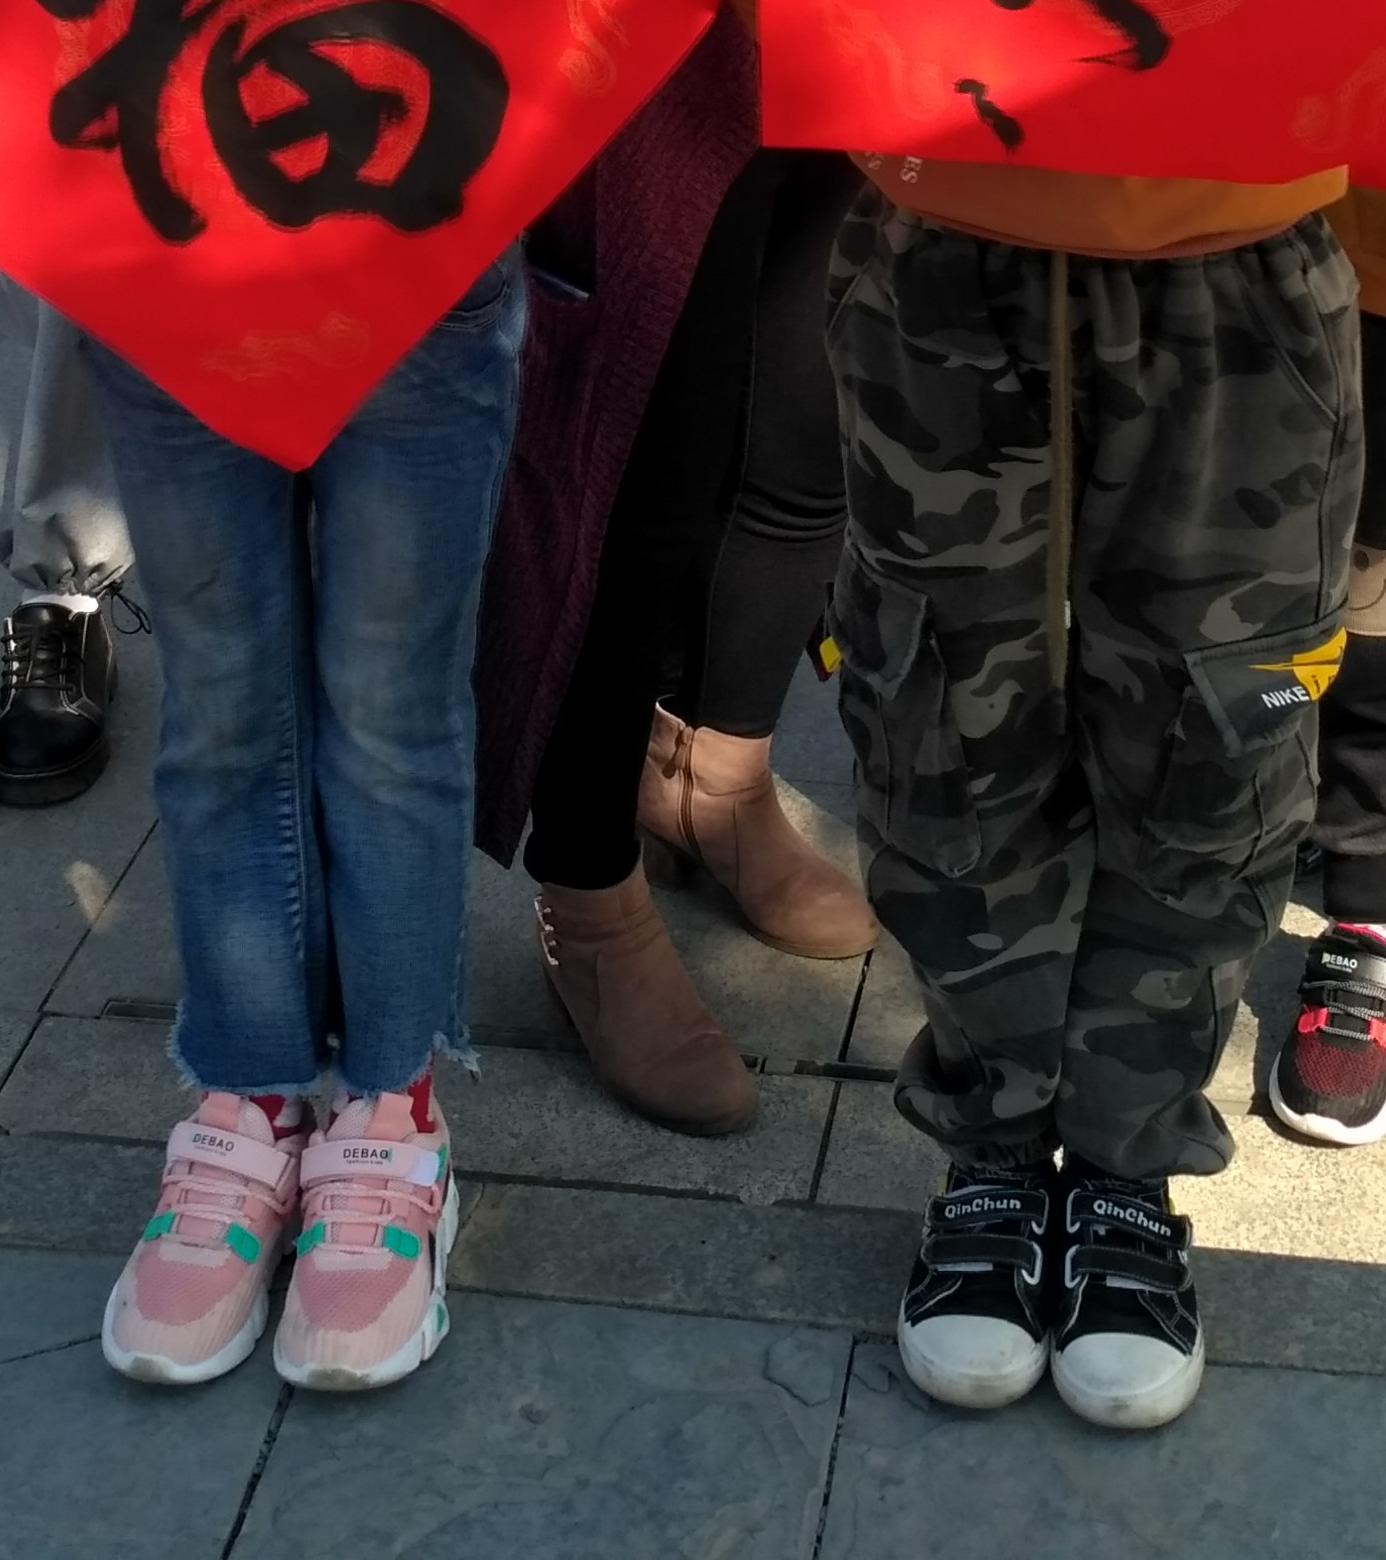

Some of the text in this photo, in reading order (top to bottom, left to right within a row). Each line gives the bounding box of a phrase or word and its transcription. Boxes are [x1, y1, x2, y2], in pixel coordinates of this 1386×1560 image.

[1260, 685, 1311, 709] NIKE
[1321, 951, 1358, 969] DEBAO
[192, 1133, 235, 1152] DEBAO
[343, 1148, 389, 1160] DEBAO
[944, 1196, 1021, 1219] QinChun
[1093, 1198, 1172, 1237] QinChun
